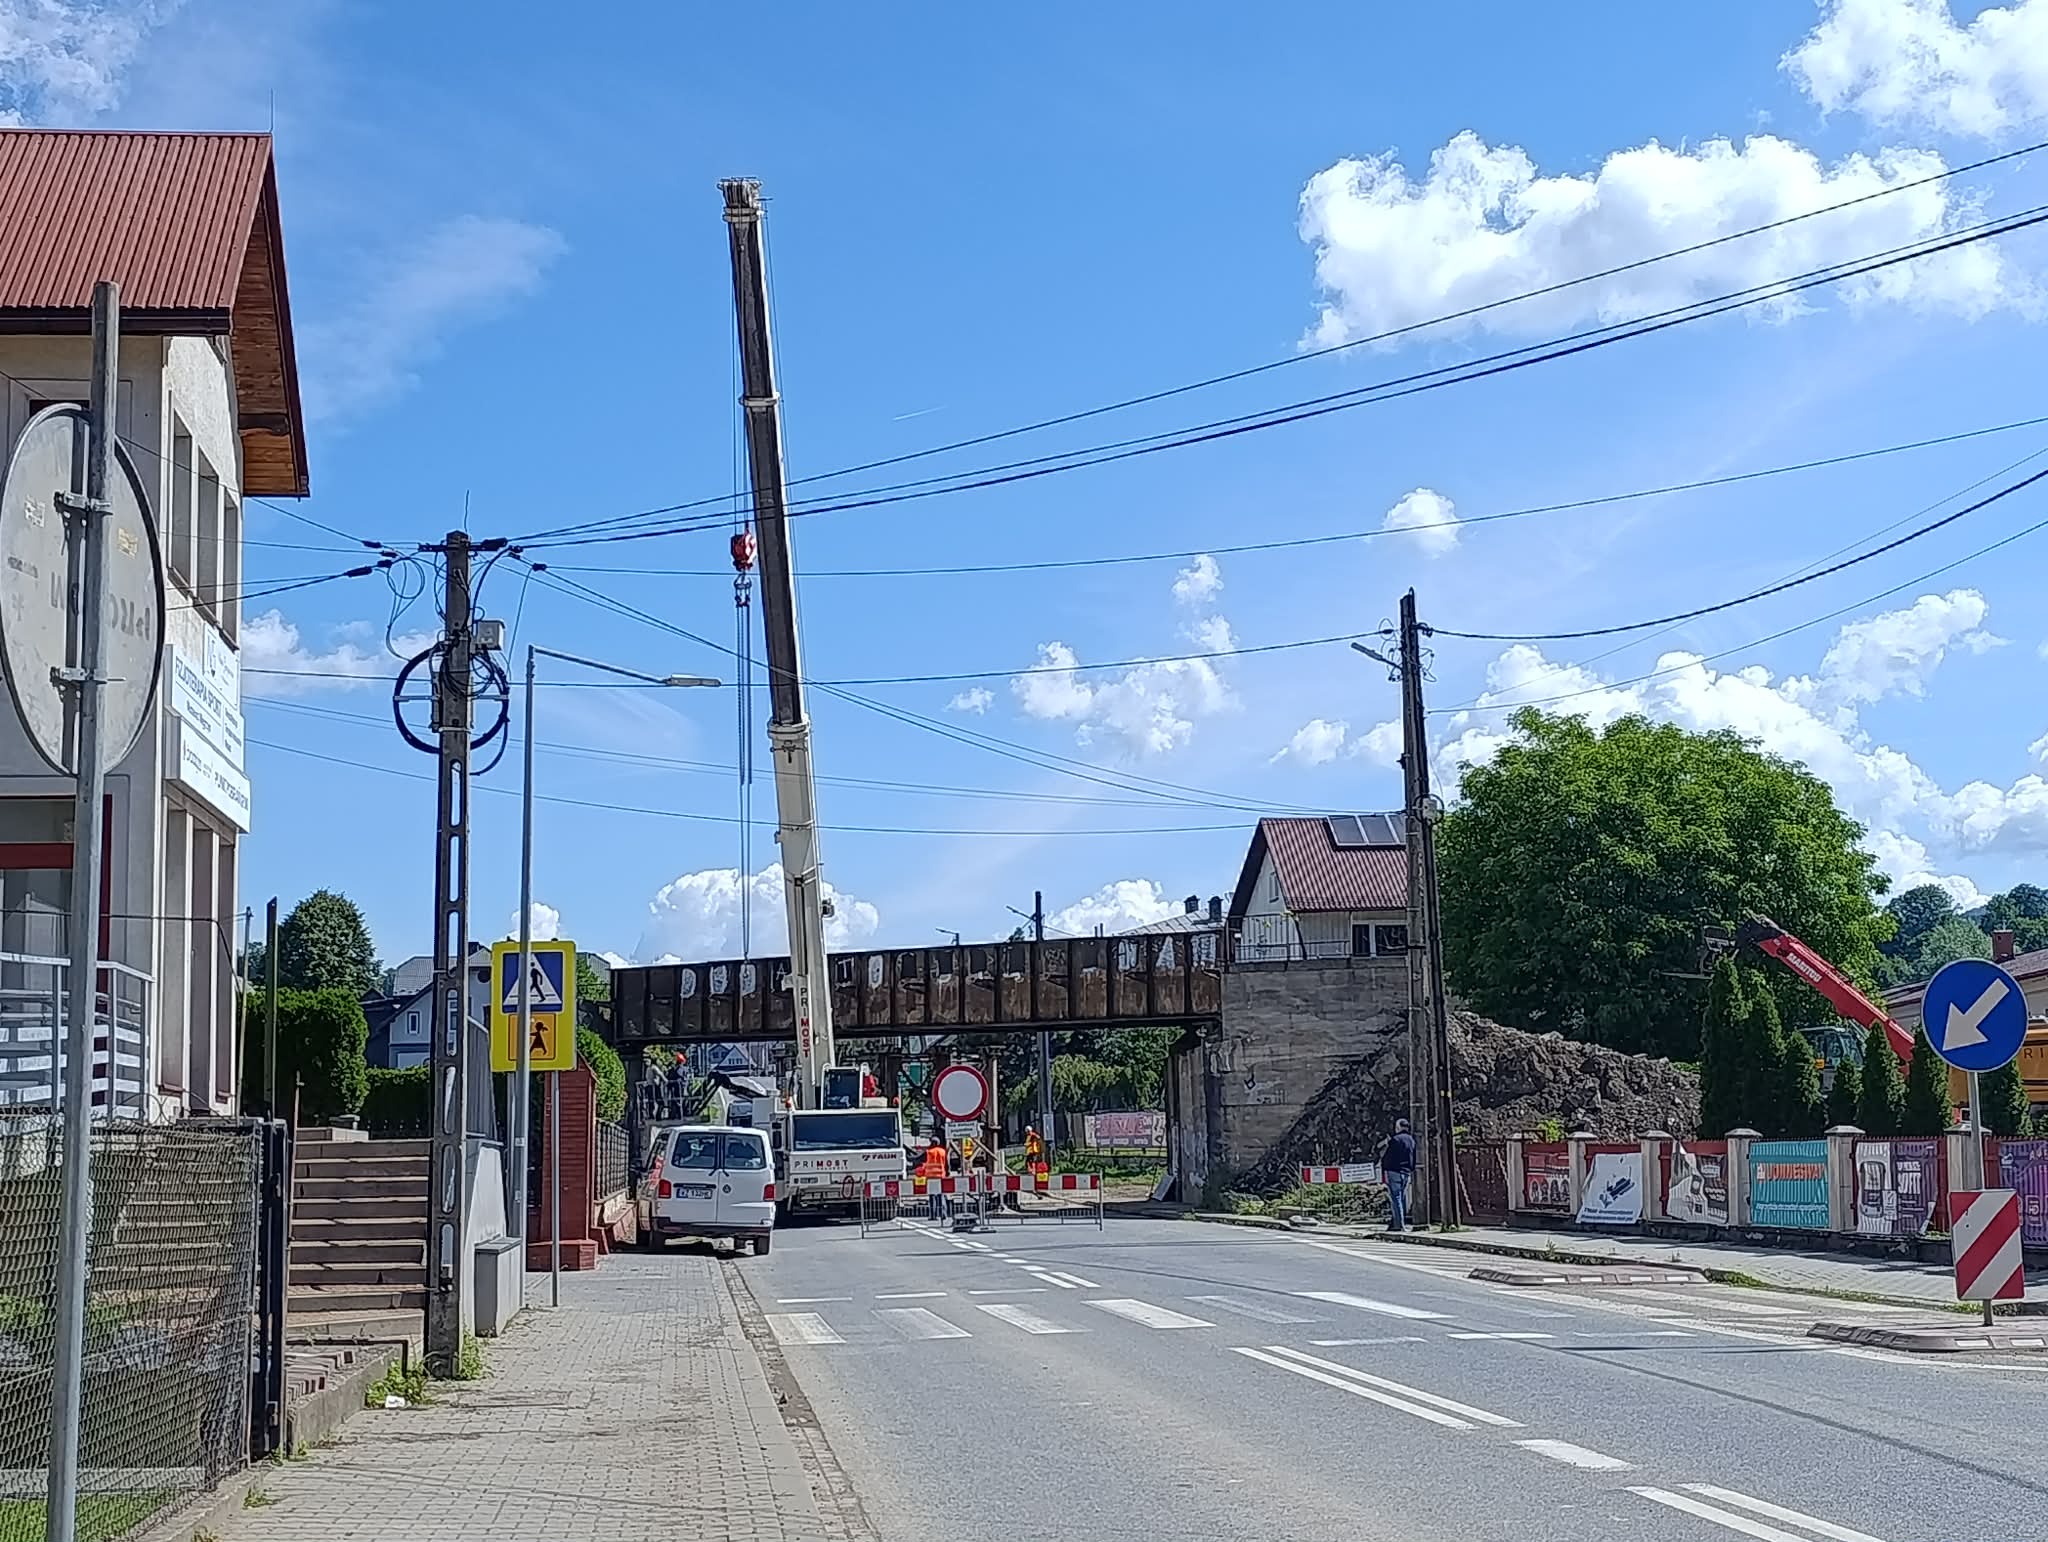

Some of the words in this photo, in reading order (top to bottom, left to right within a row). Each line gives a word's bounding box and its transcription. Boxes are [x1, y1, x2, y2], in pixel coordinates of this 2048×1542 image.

[1786, 952, 1823, 983] MANITOU
[801, 987, 811, 1058] PRIMOST
[794, 1159, 849, 1169] PRIMOST
